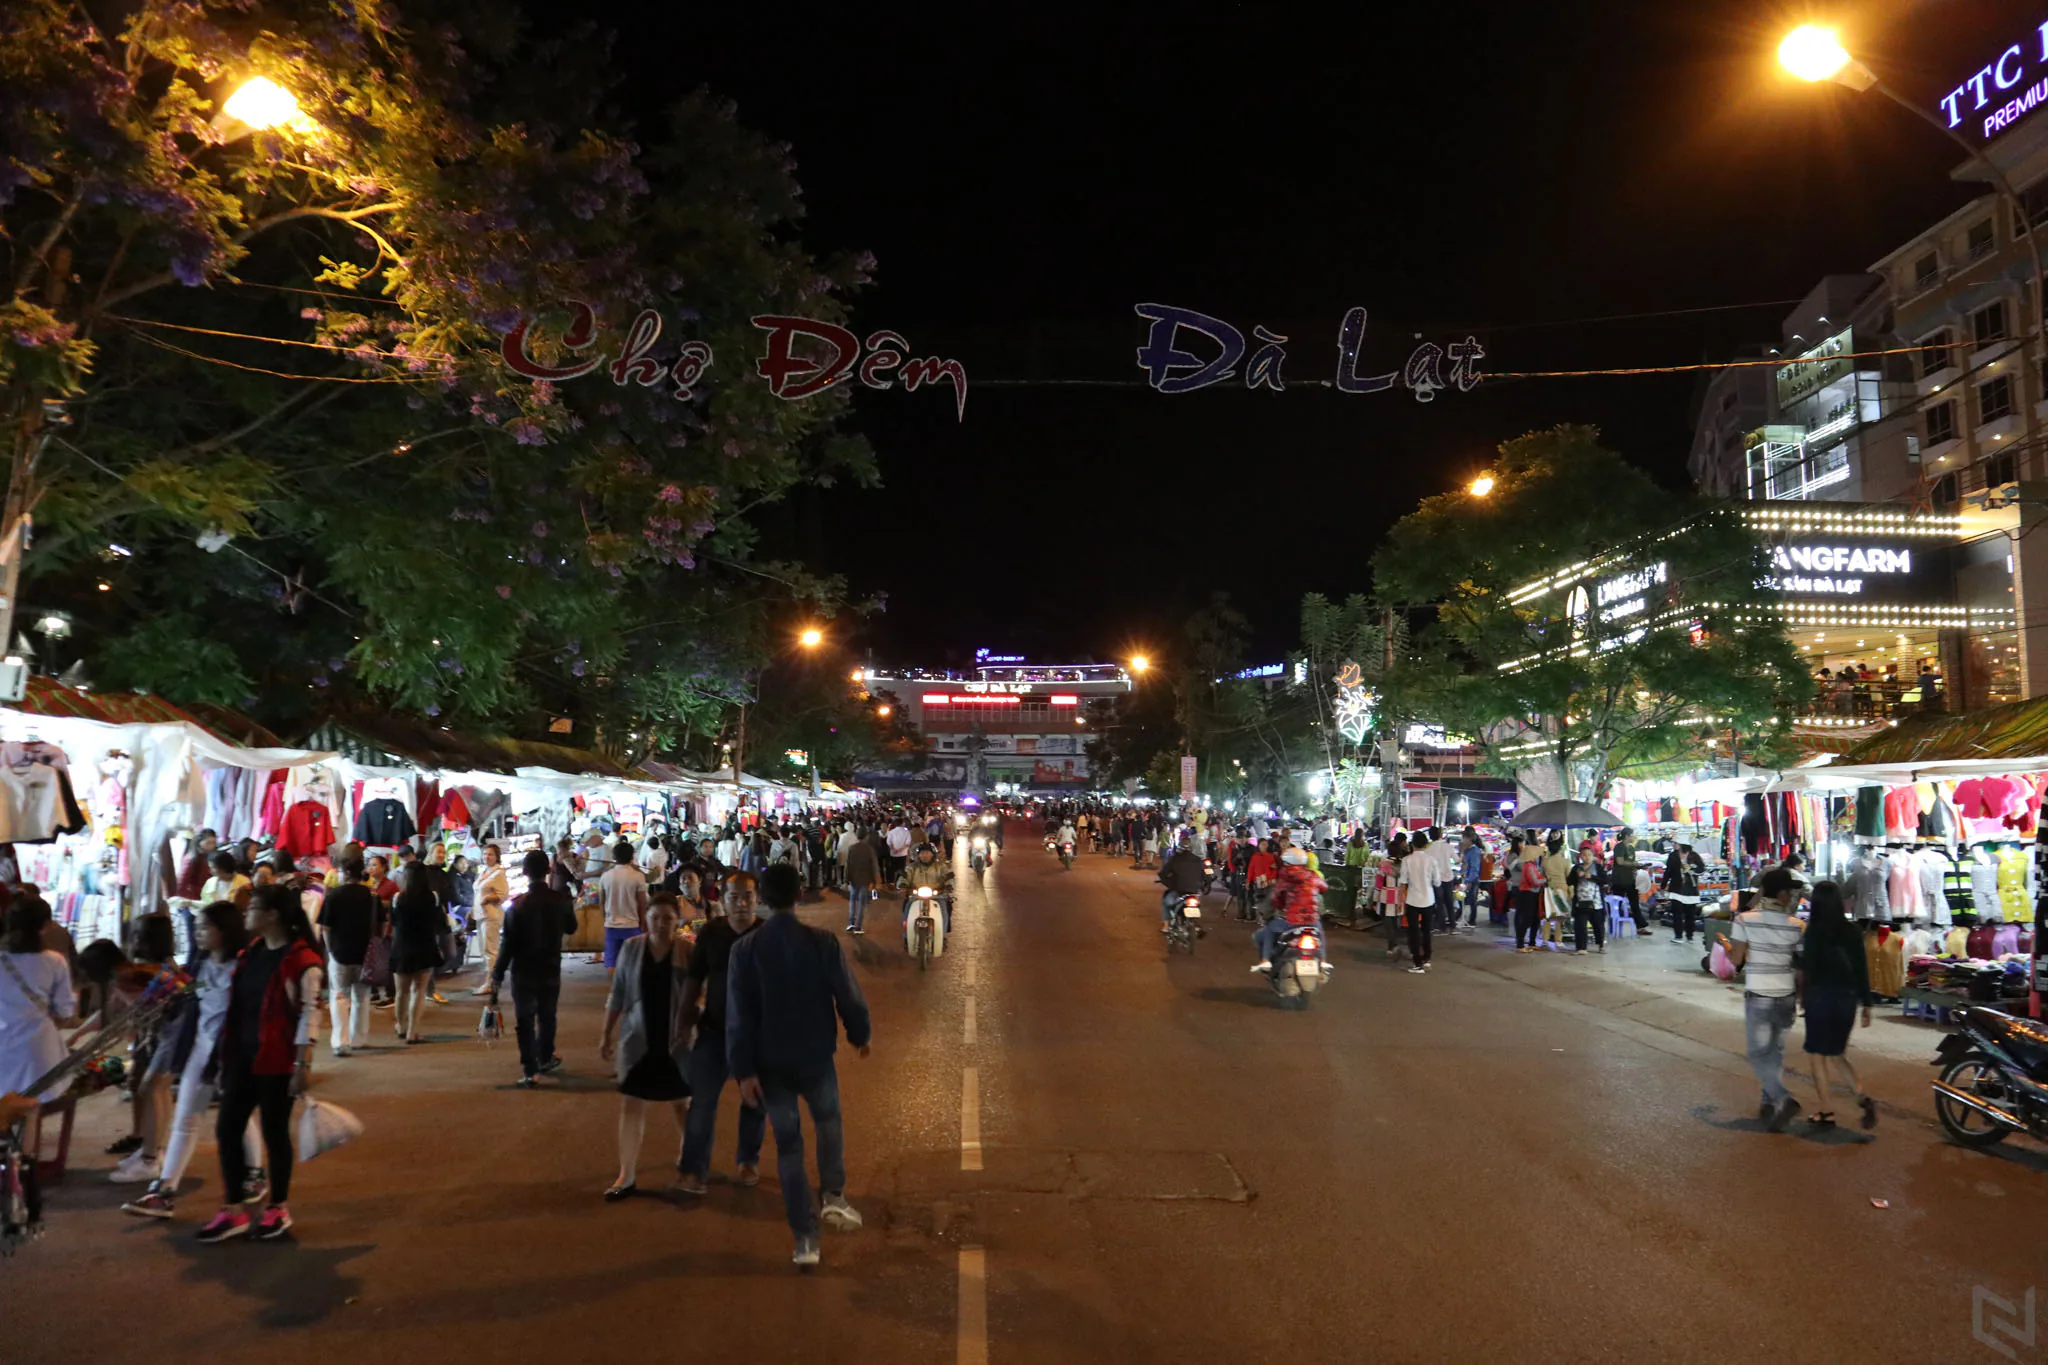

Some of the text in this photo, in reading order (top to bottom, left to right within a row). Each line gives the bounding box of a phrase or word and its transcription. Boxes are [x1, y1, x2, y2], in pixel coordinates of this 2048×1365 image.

[1940, 43, 2022, 129] TTC
[750, 313, 967, 424] Đêm
[1134, 302, 1288, 393] Đà
